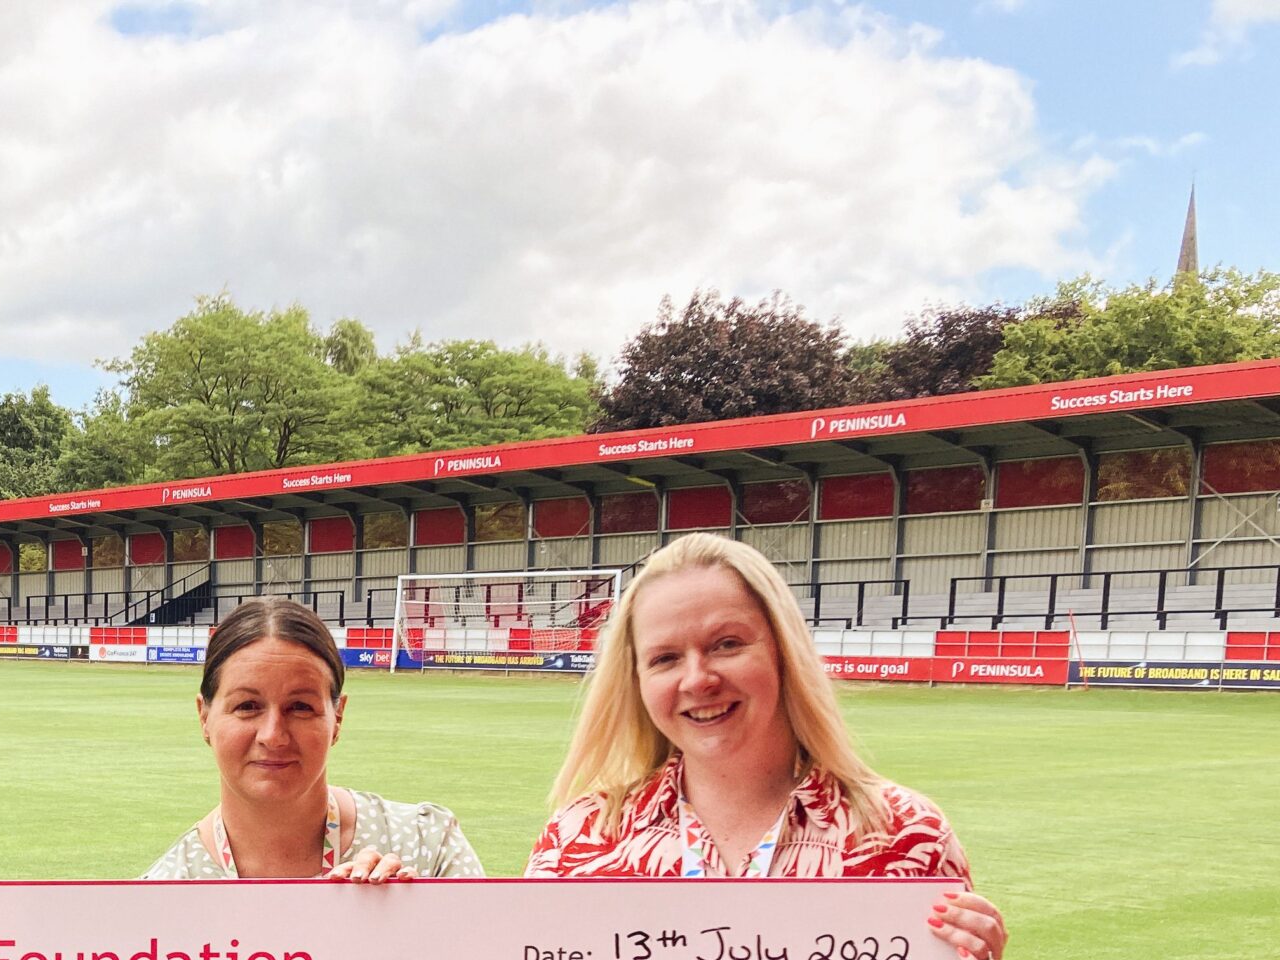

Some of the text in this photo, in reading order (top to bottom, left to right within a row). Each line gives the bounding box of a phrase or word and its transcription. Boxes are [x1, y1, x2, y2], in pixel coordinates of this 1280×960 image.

[1051, 385, 1193, 410] Success Starts Here
[829, 413, 906, 433] PENINSULA
[599, 437, 693, 456] Success Starts Here
[447, 455, 501, 471] PENINSULA
[283, 473, 351, 489] Success Starts Here
[172, 486, 212, 500] PENINSULA
[49, 500, 101, 512] Success Starts Here
[359, 652, 389, 664] sky bet
[823, 661, 909, 678] ers is our goal
[970, 664, 1043, 677] PENINSULA
[1079, 667, 1096, 678] THE
[1097, 667, 1132, 678] FUTURE
[1135, 667, 1146, 678] OF
[1148, 667, 1208, 679] BROADBAND
[1210, 668, 1220, 679] IS
[1222, 668, 1248, 680] HERE
[1249, 669, 1261, 680] IN
[614, 929, 688, 960] 13th
